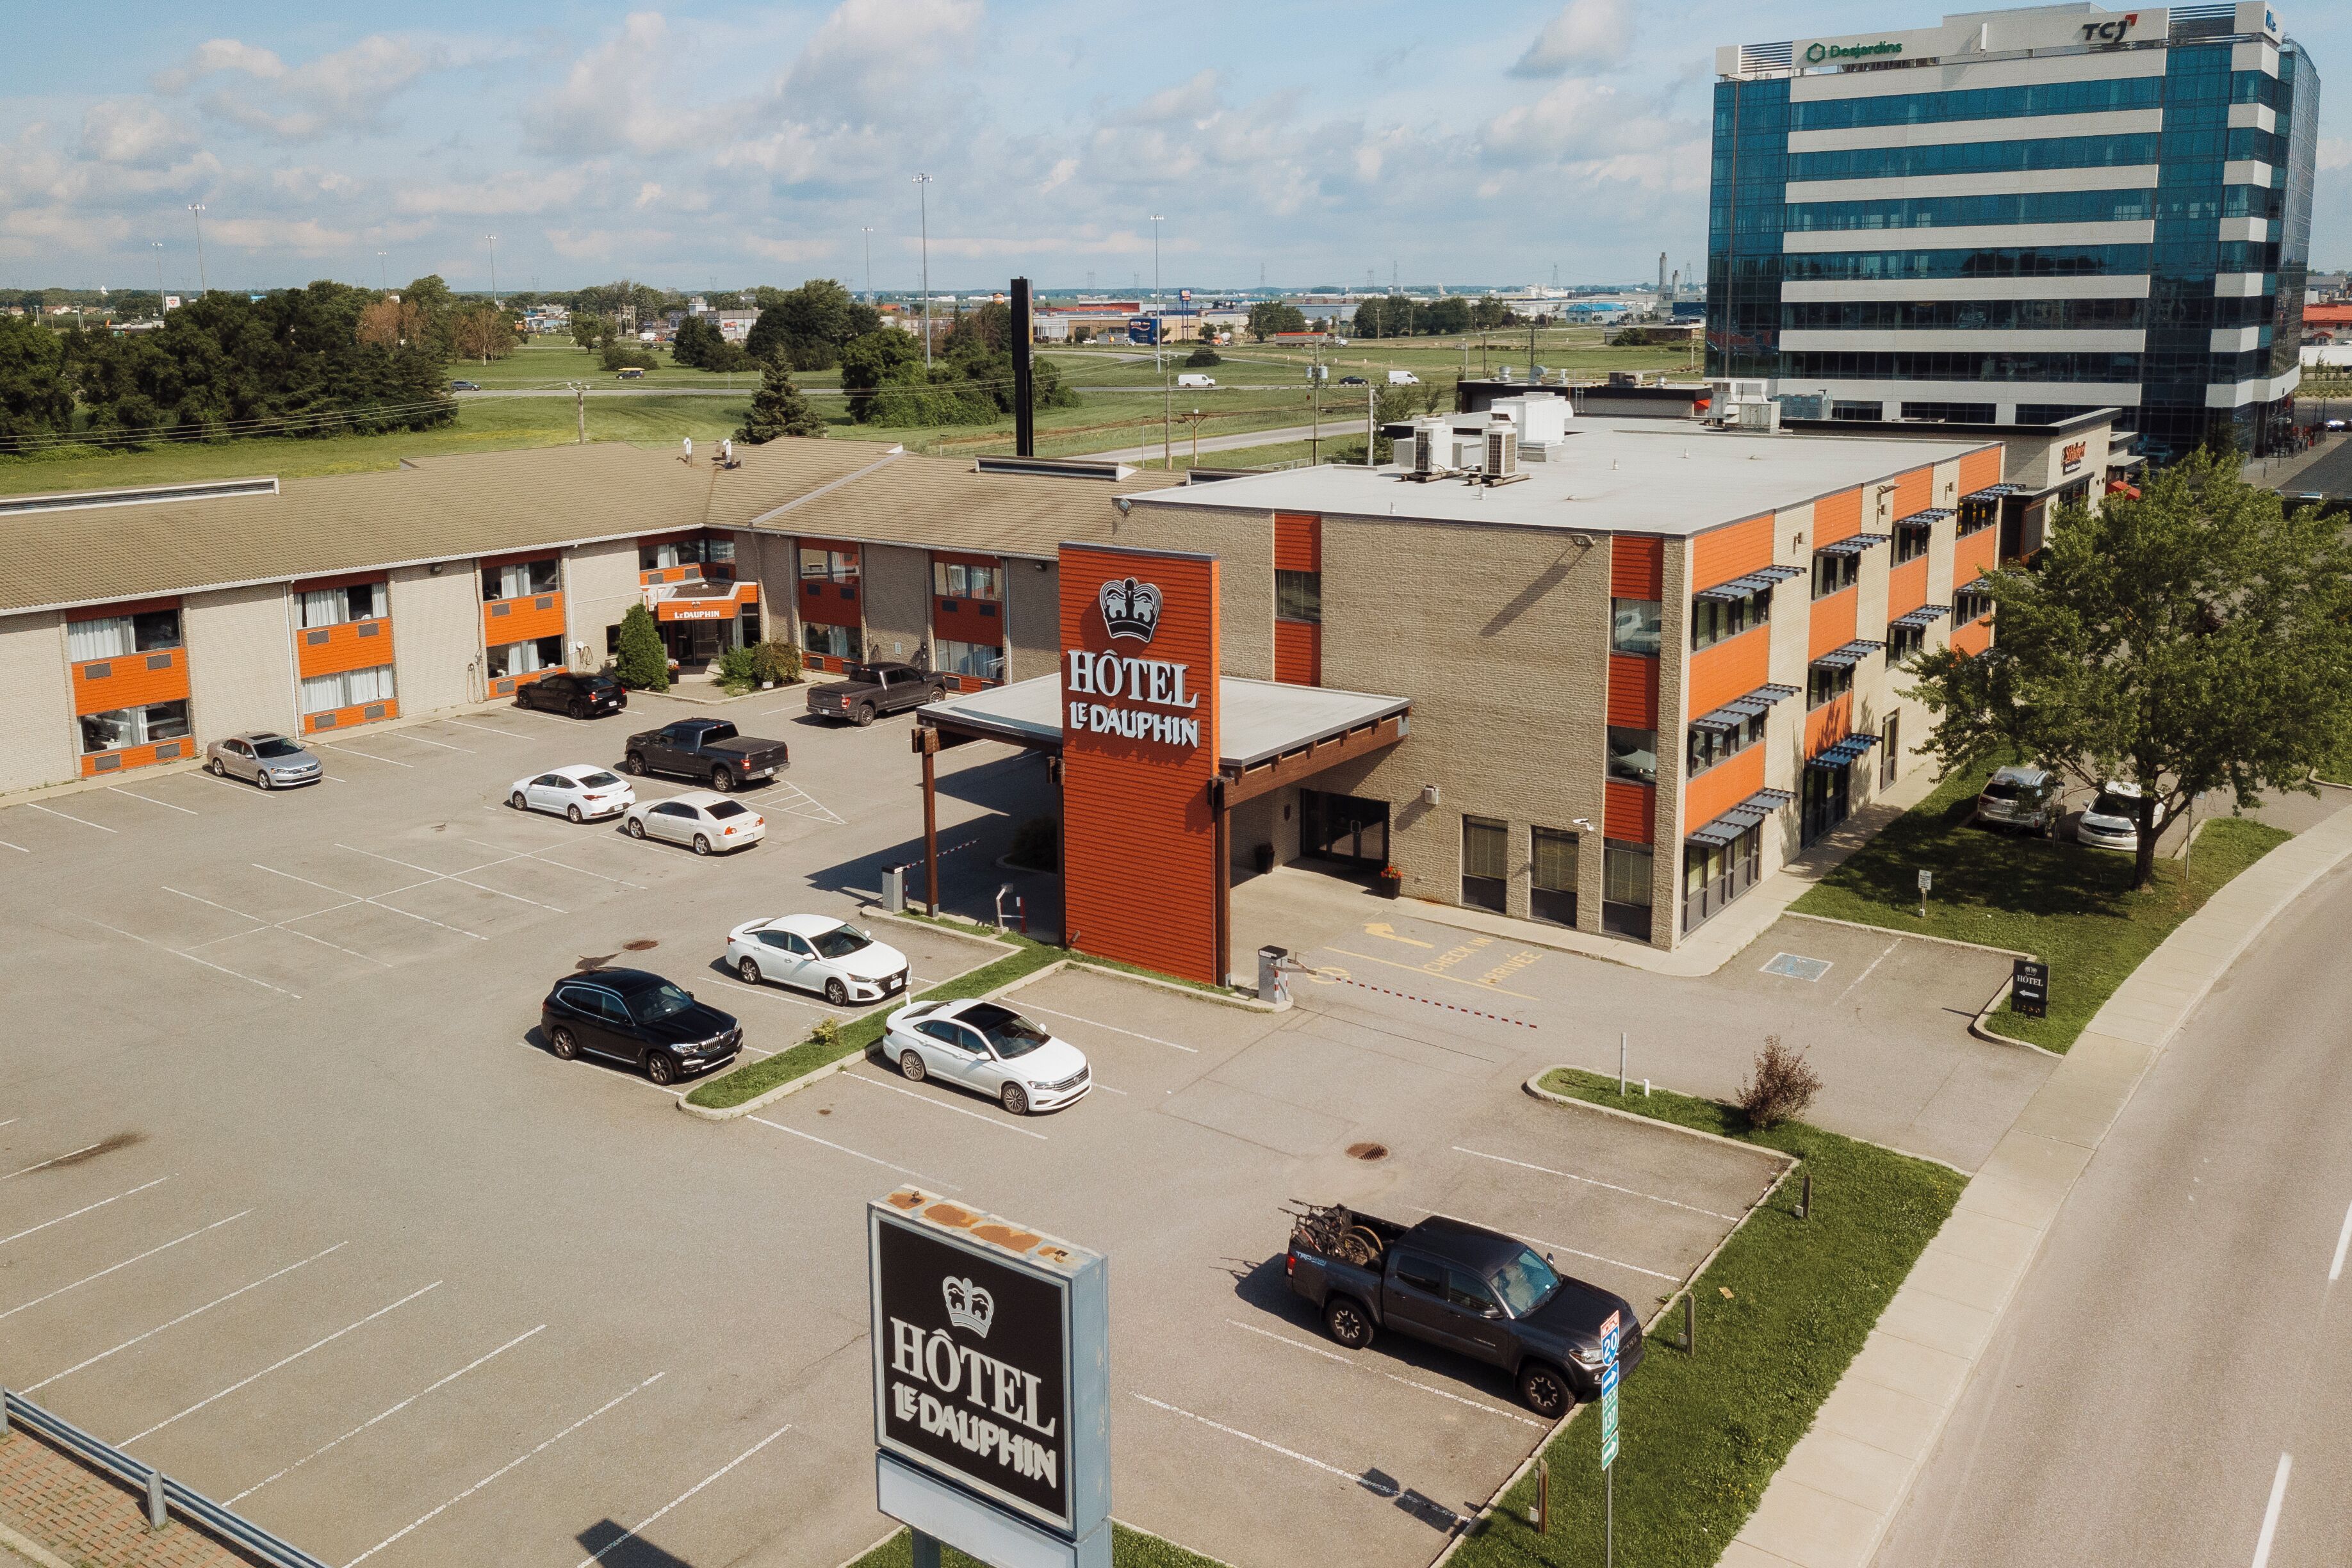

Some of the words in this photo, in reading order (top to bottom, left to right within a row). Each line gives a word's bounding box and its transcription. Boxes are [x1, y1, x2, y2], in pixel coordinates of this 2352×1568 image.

[2082, 20, 2127, 44] TCJ
[1830, 41, 1902, 59] Desjardins
[1068, 649, 1199, 708] HÔTEL
[1069, 701, 1088, 730] LE
[1090, 704, 1200, 748] DAUPHIN
[1423, 945, 1478, 972] CHECK
[1467, 937, 1494, 947] IN
[1476, 951, 1543, 984] ARRIVÉE
[2016, 974, 2043, 987] HÔTEL
[1604, 1332, 1617, 1359] 20
[890, 1316, 1057, 1437] HÔTEL
[892, 1382, 919, 1422] LE
[919, 1392, 1057, 1489] DAUPHIN
[1604, 1408, 1617, 1433] 137
